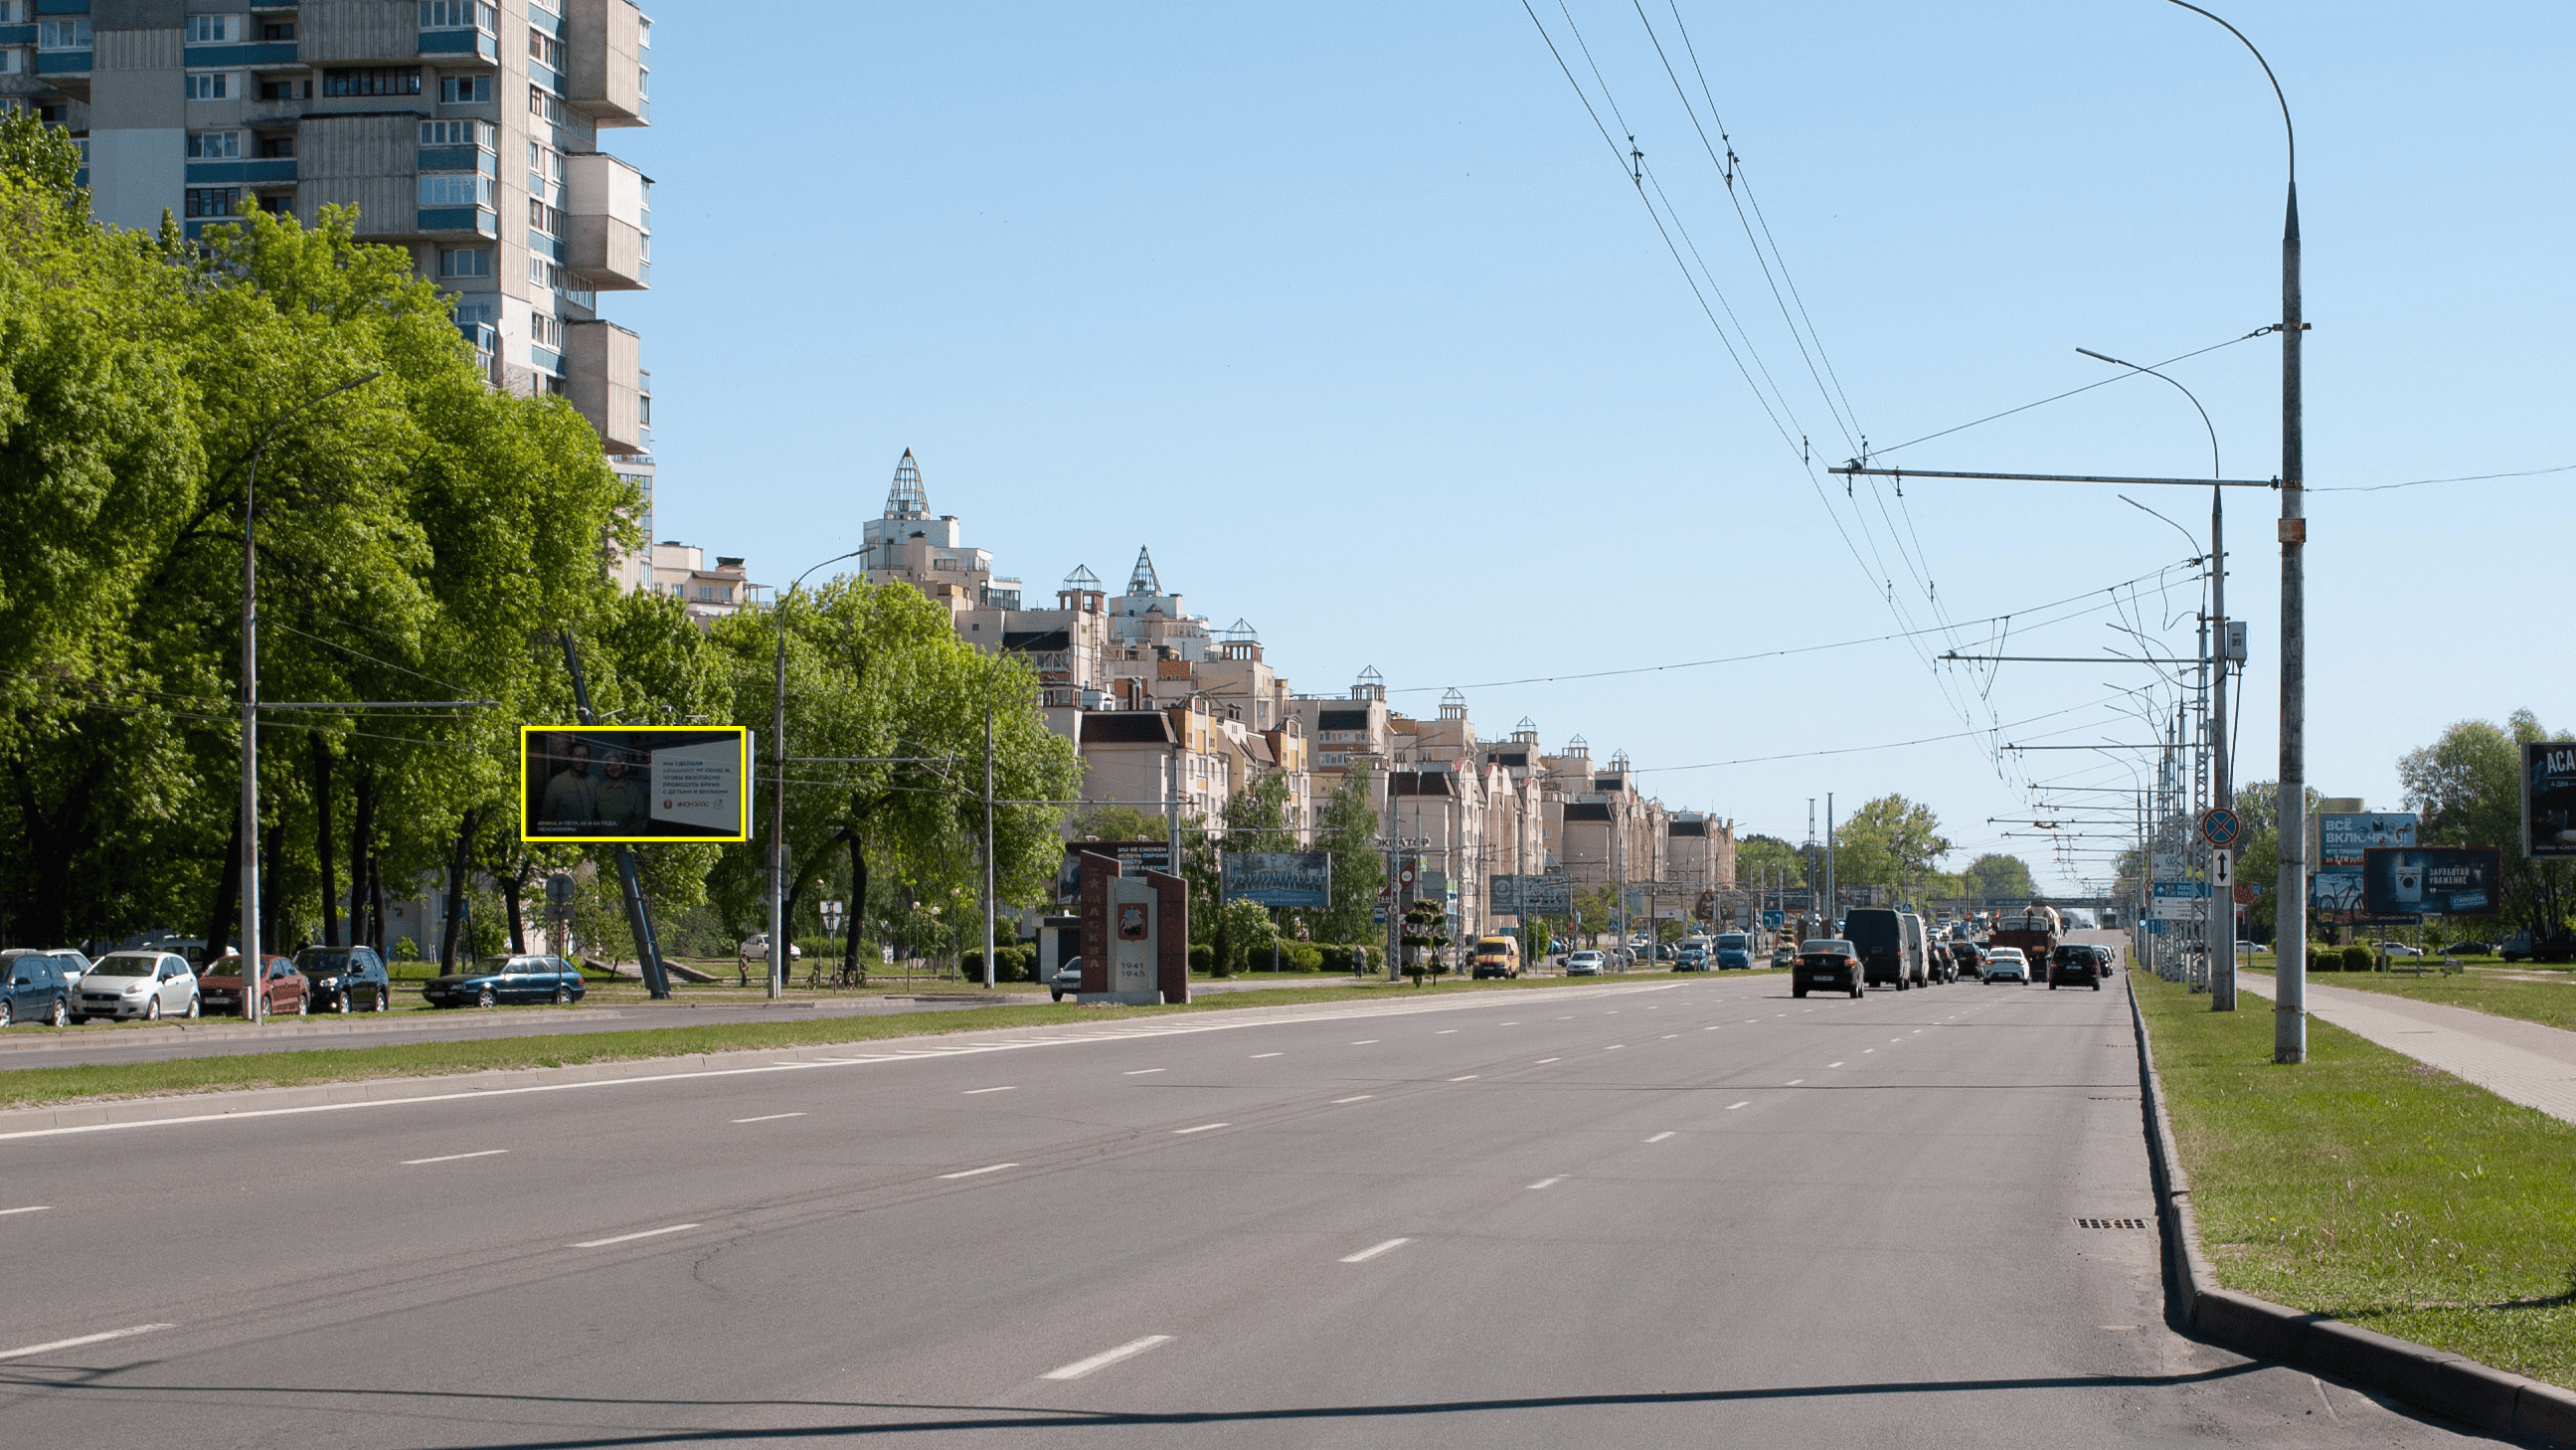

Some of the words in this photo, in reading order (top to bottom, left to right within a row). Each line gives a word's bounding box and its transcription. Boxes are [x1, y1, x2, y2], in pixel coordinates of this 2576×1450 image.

[2325, 817, 2352, 830] ВСЁ
[2429, 867, 2470, 876] ЗАРАБОТАЙ
[2429, 876, 2468, 885] УВАЖЕНИЕ
[1088, 894, 1102, 969] МАСКВА
